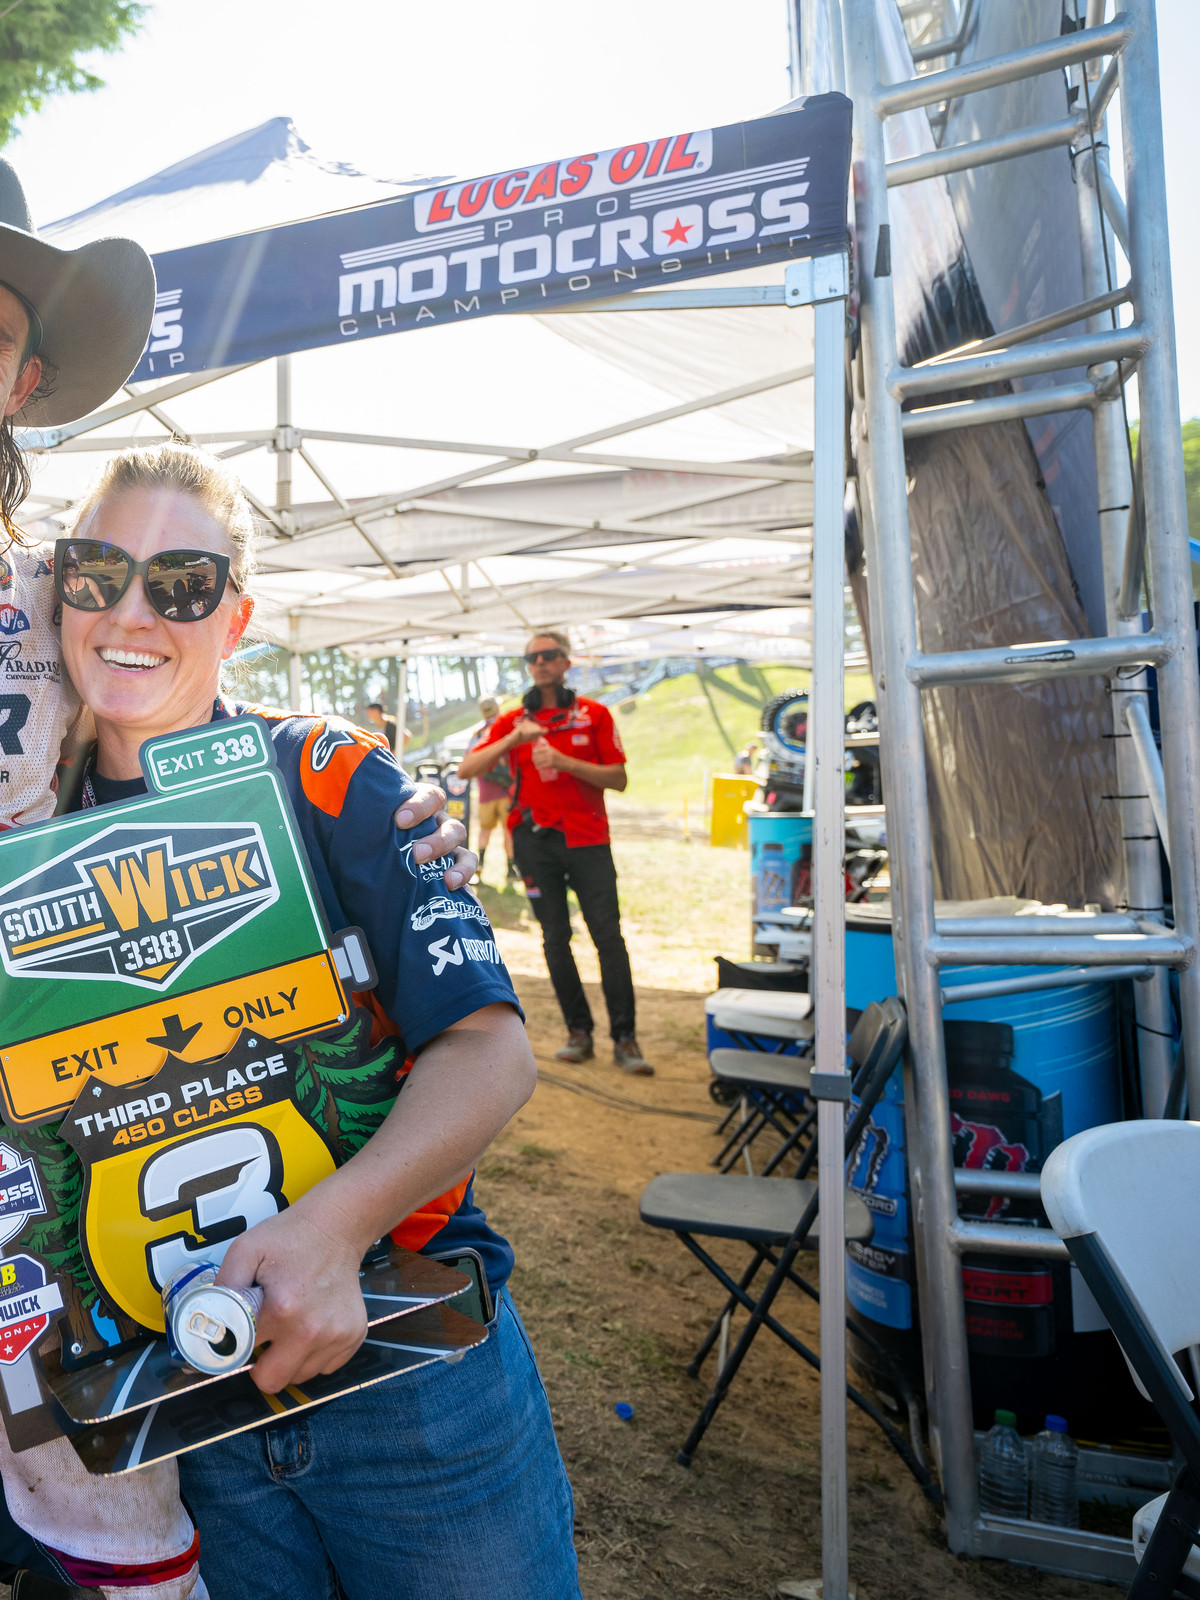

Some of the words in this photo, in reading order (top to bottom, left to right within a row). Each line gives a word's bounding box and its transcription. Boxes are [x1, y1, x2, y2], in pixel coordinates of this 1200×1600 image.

[426, 153, 598, 225] LUCAS
[608, 132, 697, 185] OIL
[494, 197, 619, 237] PRO
[338, 182, 810, 316] MOTOCROSS
[156, 749, 206, 777] EXIT
[211, 734, 257, 765] 338
[119, 930, 182, 972] 338
[51, 1041, 120, 1083] EXIT
[223, 987, 298, 1029] ONLY
[74, 1092, 171, 1137] THIRD
[180, 1053, 288, 1104] PLACE
[112, 1117, 166, 1146] 450
[172, 1086, 263, 1128] CLASS
[947, 1088, 963, 1099] ED
[967, 1090, 1011, 1103] DAWG
[143, 1127, 280, 1293] 3
[964, 1285, 1029, 1299] ORT
